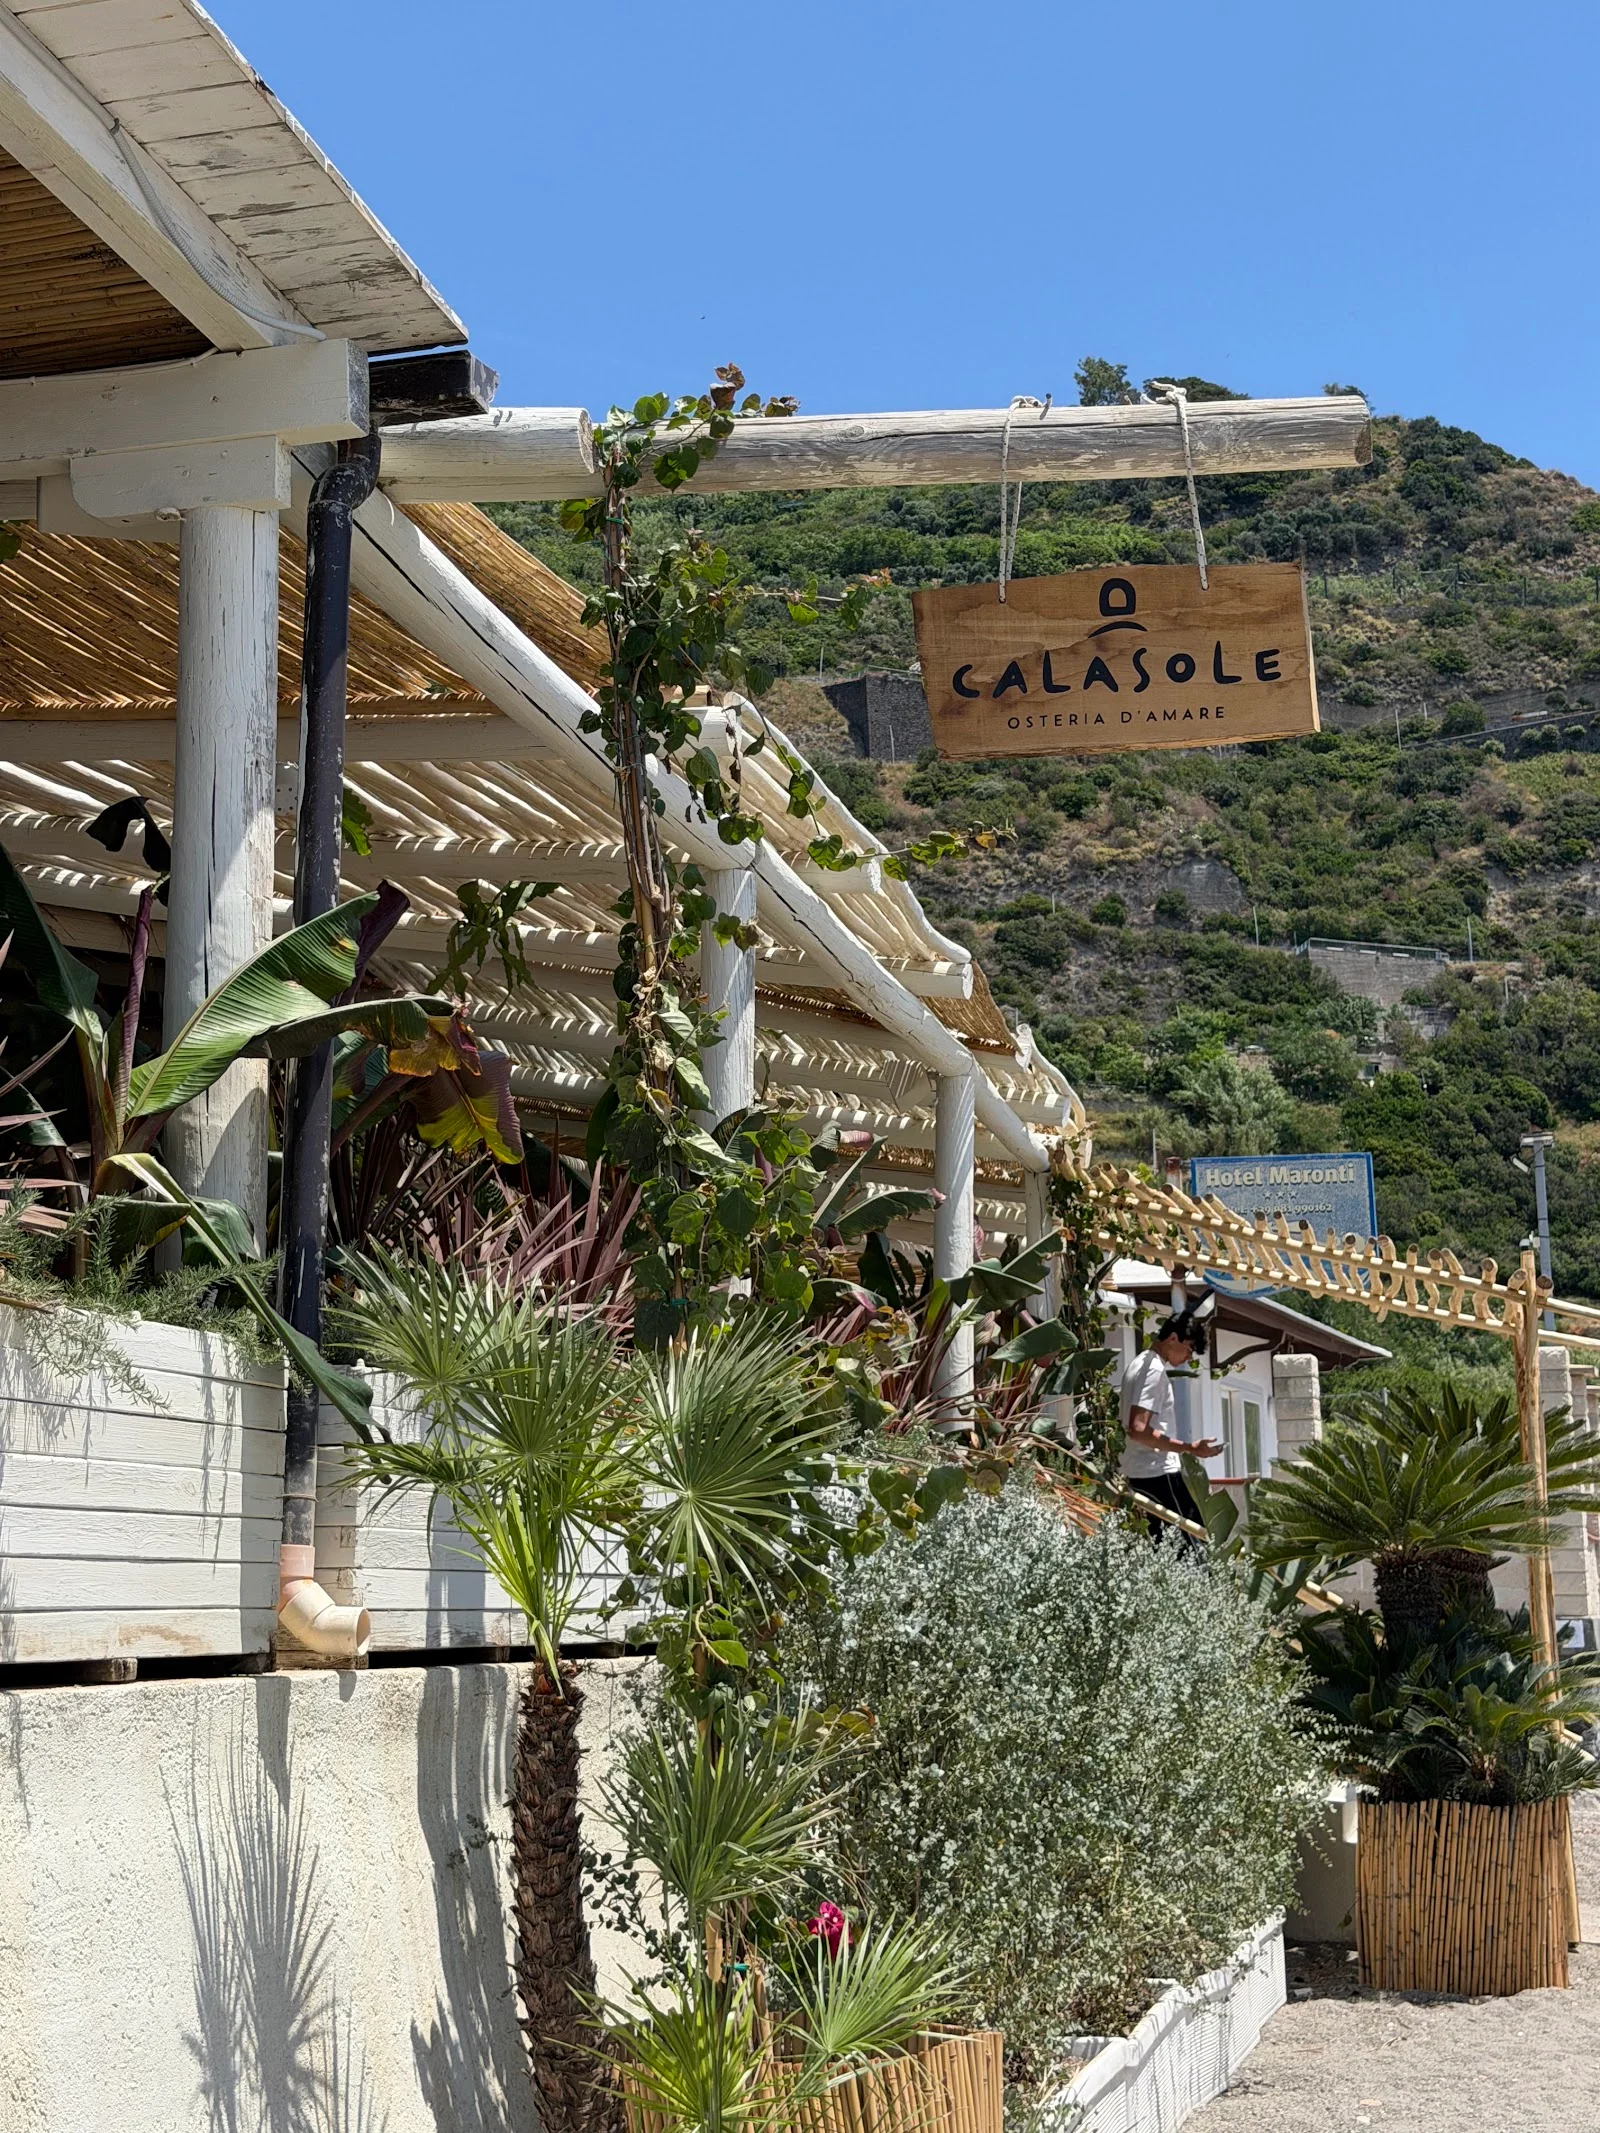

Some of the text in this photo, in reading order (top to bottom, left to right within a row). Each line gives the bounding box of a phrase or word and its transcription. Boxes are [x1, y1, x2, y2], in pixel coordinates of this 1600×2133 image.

[952, 640, 1282, 699] CALASOLE
[1007, 706, 1225, 730] OSTERIA D'AMARE
[1206, 1163, 1355, 1188] Hotel Maronti
[1294, 1202, 1333, 1216] 990162
